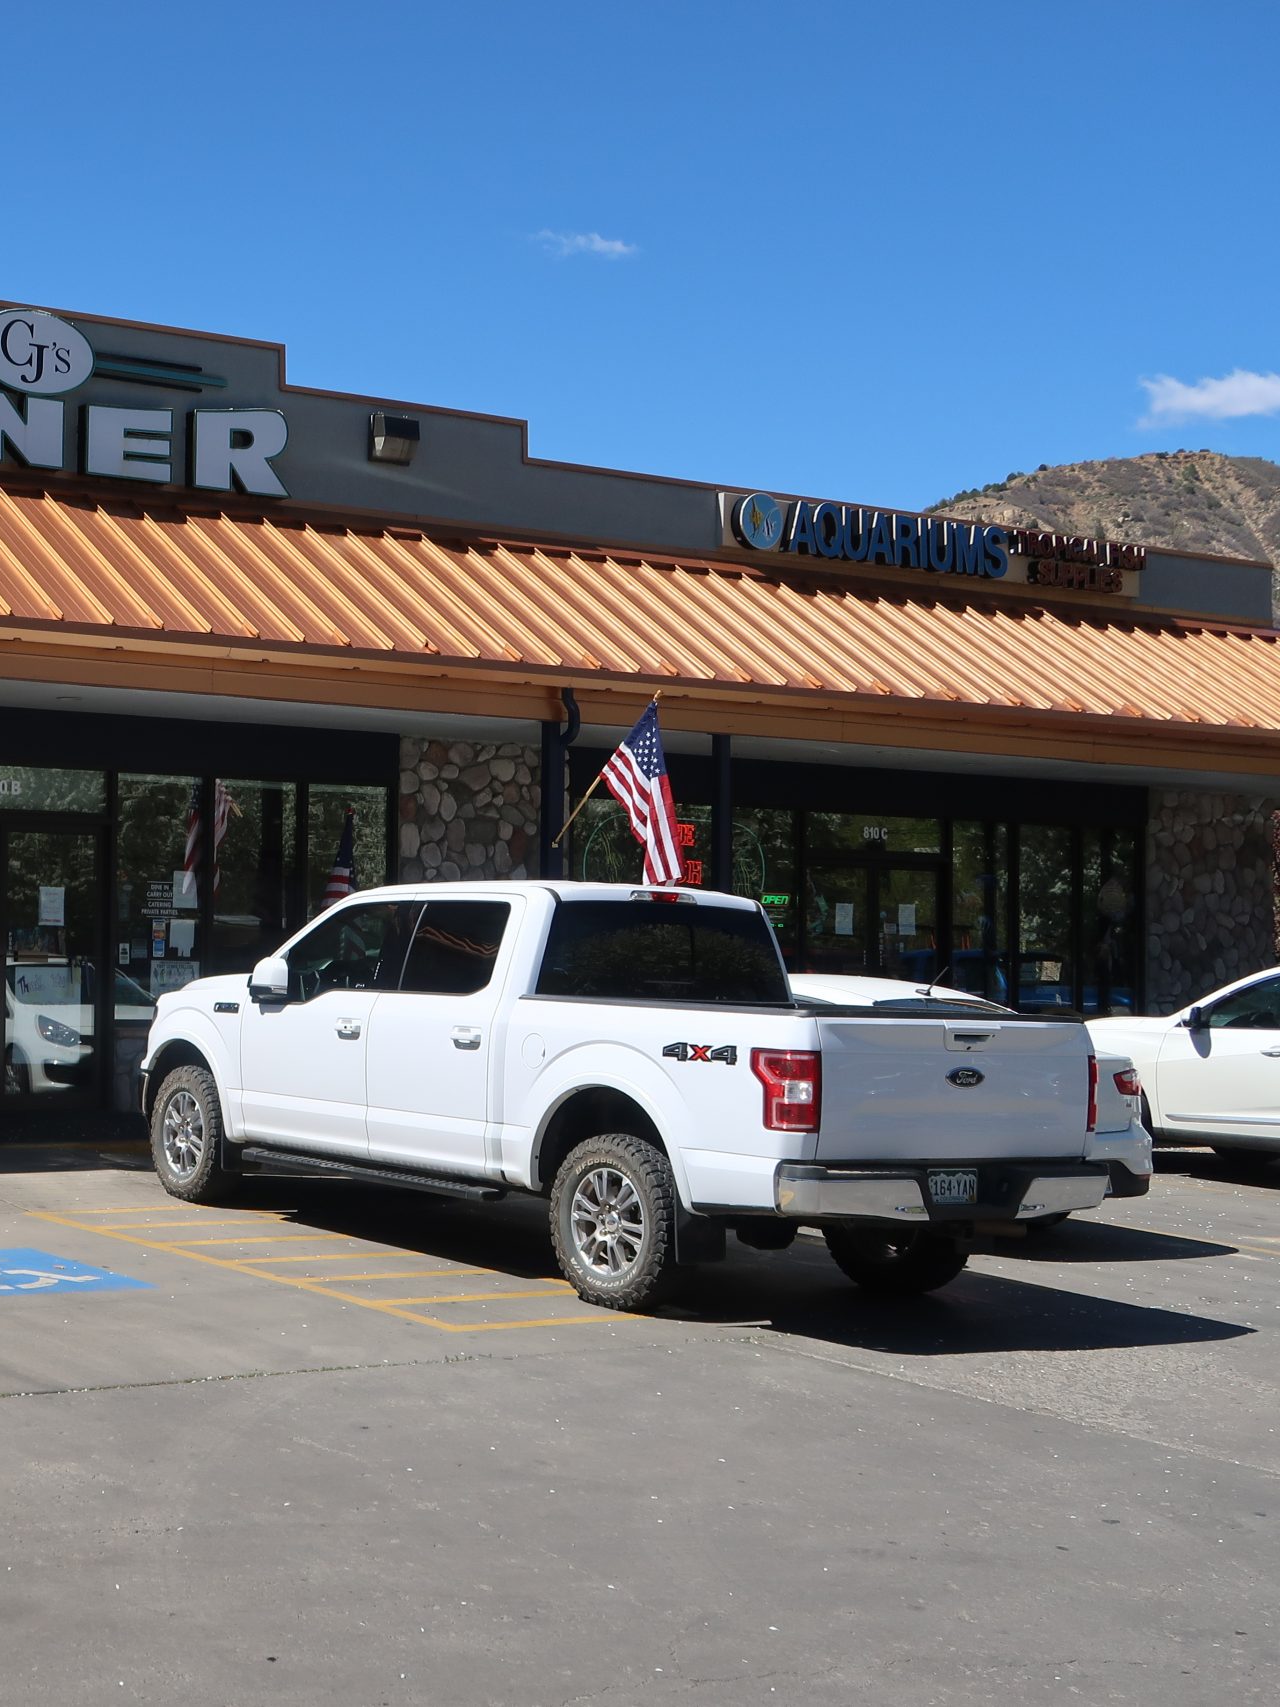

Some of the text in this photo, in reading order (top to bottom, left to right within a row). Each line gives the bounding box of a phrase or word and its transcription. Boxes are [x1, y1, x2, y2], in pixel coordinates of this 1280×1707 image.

[787, 501, 1008, 578] AQUARIUMS
[1029, 560, 1123, 593] SUPPLIES
[11, 780, 22, 796] B
[863, 826, 888, 840] 810 C
[761, 894, 789, 905] OPEN
